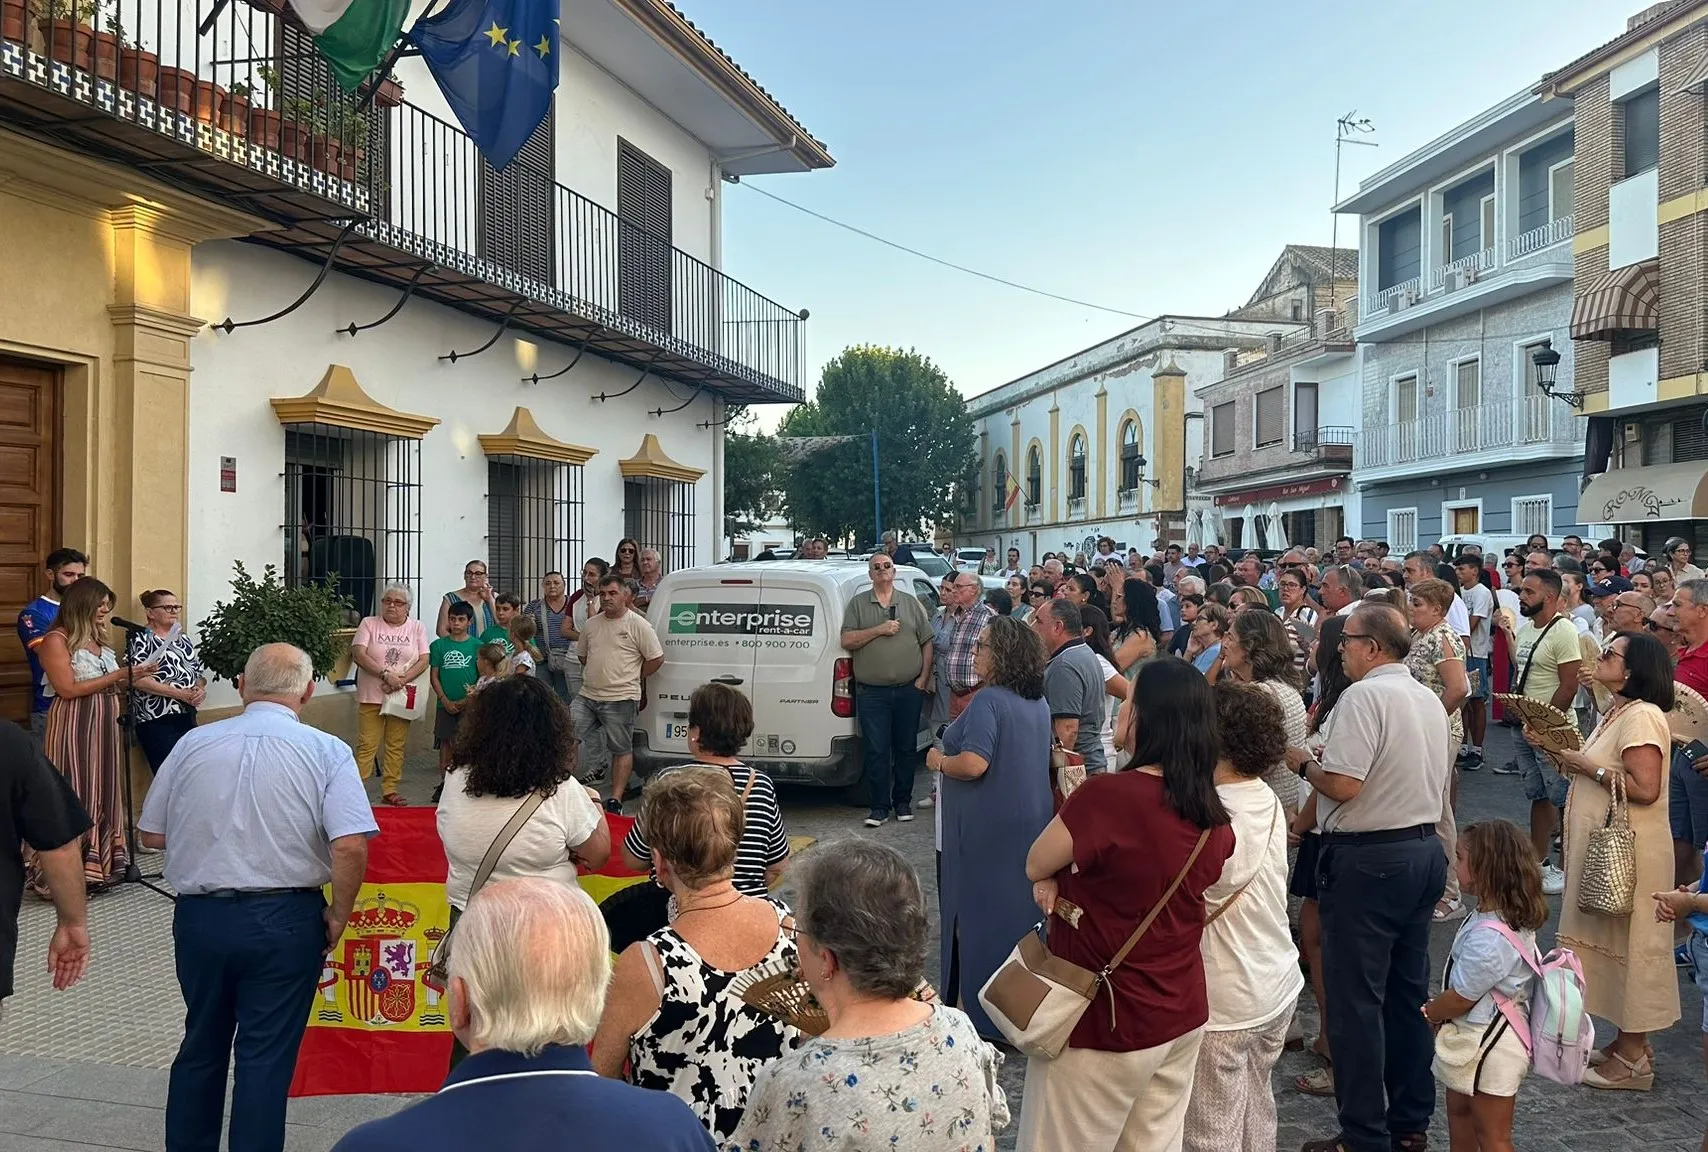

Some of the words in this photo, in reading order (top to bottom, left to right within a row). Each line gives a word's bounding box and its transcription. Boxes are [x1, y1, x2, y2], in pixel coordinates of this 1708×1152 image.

[676, 608, 811, 630] enterprise
[759, 626, 810, 635] rent-a-car
[378, 633, 410, 643] KAFKA
[665, 638, 730, 647] enterprise.es
[741, 640, 762, 648] 800
[765, 640, 786, 648] 900
[789, 641, 810, 649] 700
[658, 693, 690, 701] PEU
[674, 725, 687, 738] 95
